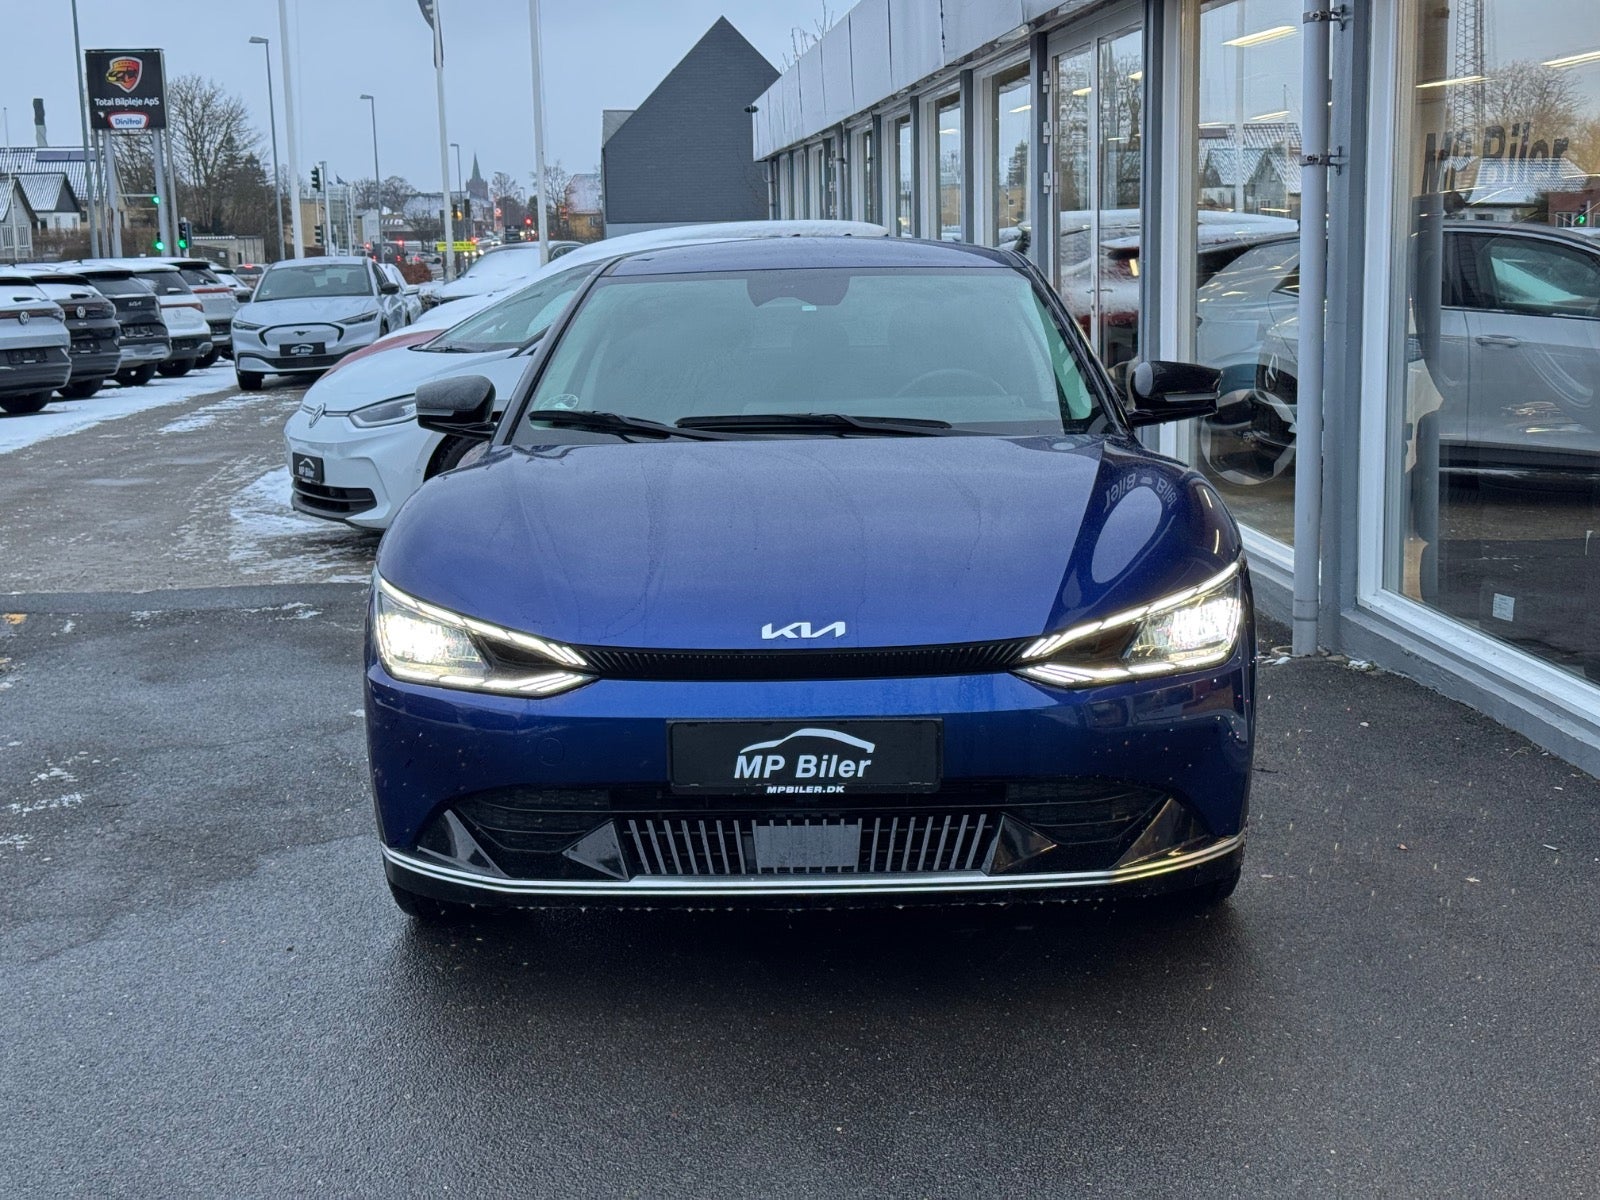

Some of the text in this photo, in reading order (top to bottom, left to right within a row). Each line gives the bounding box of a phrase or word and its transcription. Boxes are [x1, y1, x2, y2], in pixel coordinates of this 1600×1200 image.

[94, 97, 160, 107] Total Bilpleje ApS
[761, 621, 846, 640] KIA
[734, 754, 871, 779] MP Biler
[766, 785, 846, 794] MPBILER.DK
